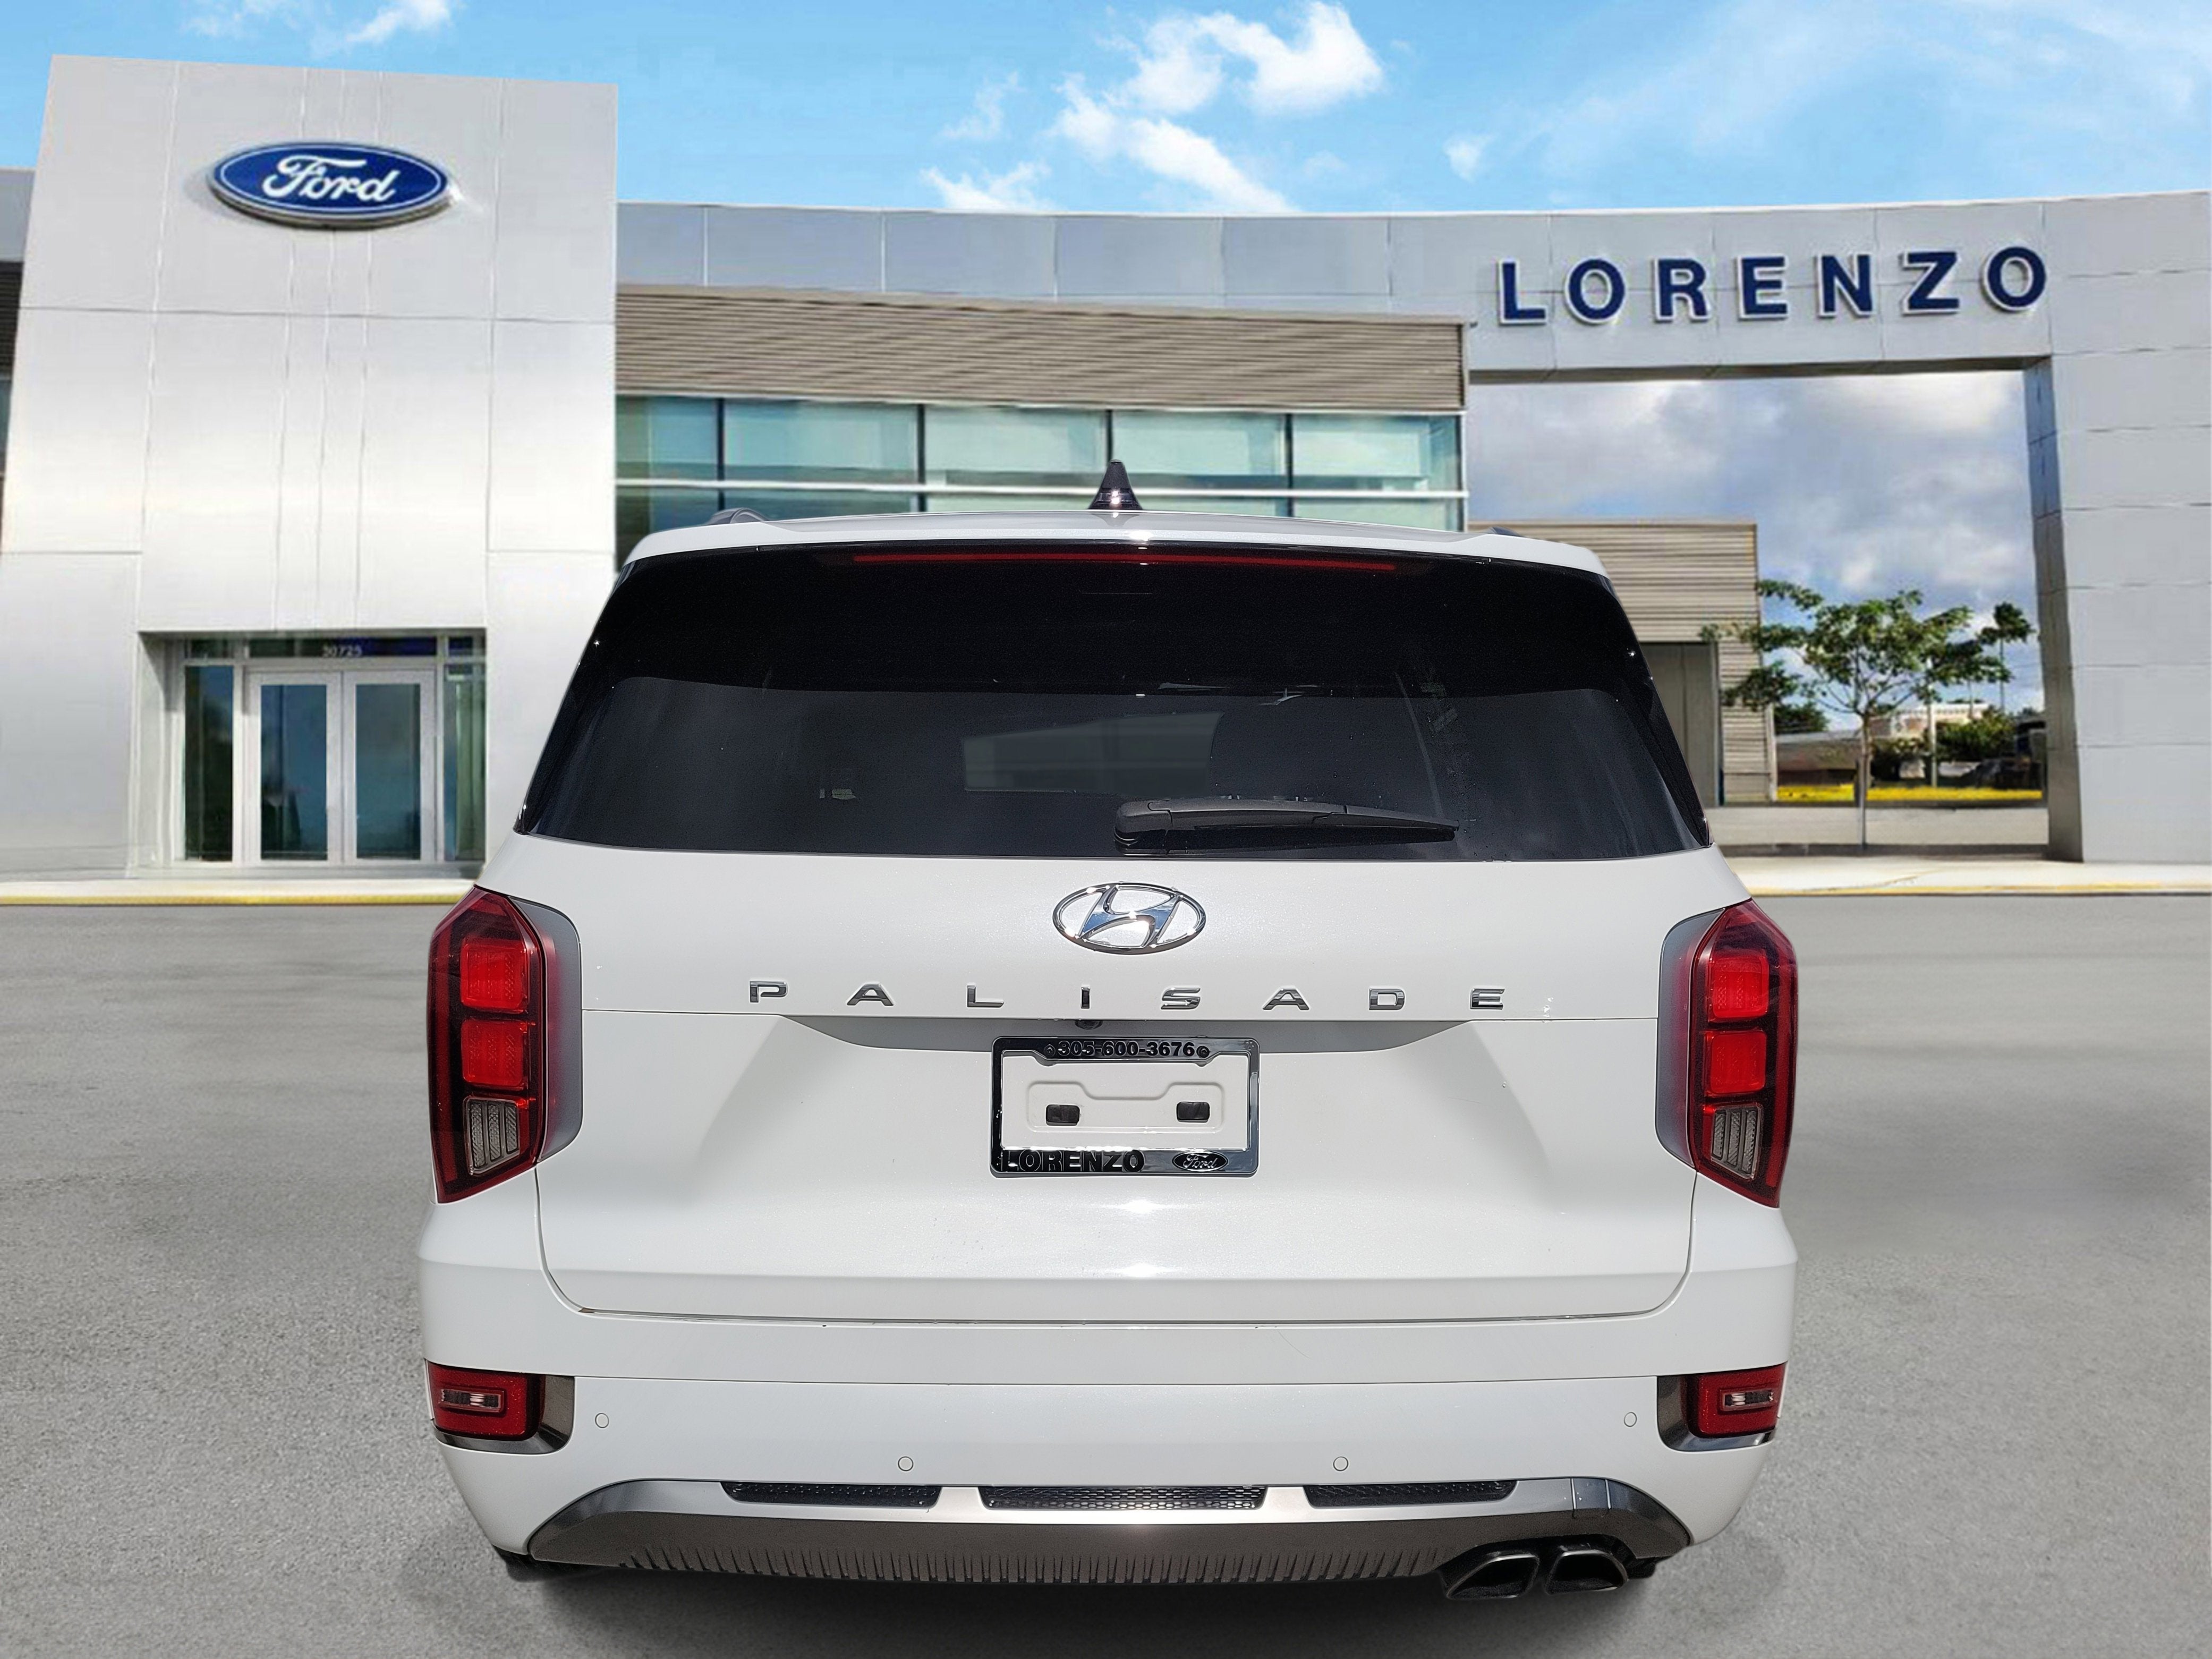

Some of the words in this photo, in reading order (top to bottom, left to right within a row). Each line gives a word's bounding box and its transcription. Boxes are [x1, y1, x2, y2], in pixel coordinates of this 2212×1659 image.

[262, 154, 399, 202] Ford
[1498, 246, 2047, 325] LORENZO
[750, 981, 1505, 1011] PALISADE
[1057, 1041, 1196, 1056] 305-600-3676
[1001, 1149, 1145, 1172] LORENZO
[1183, 1153, 1218, 1169] Ford
